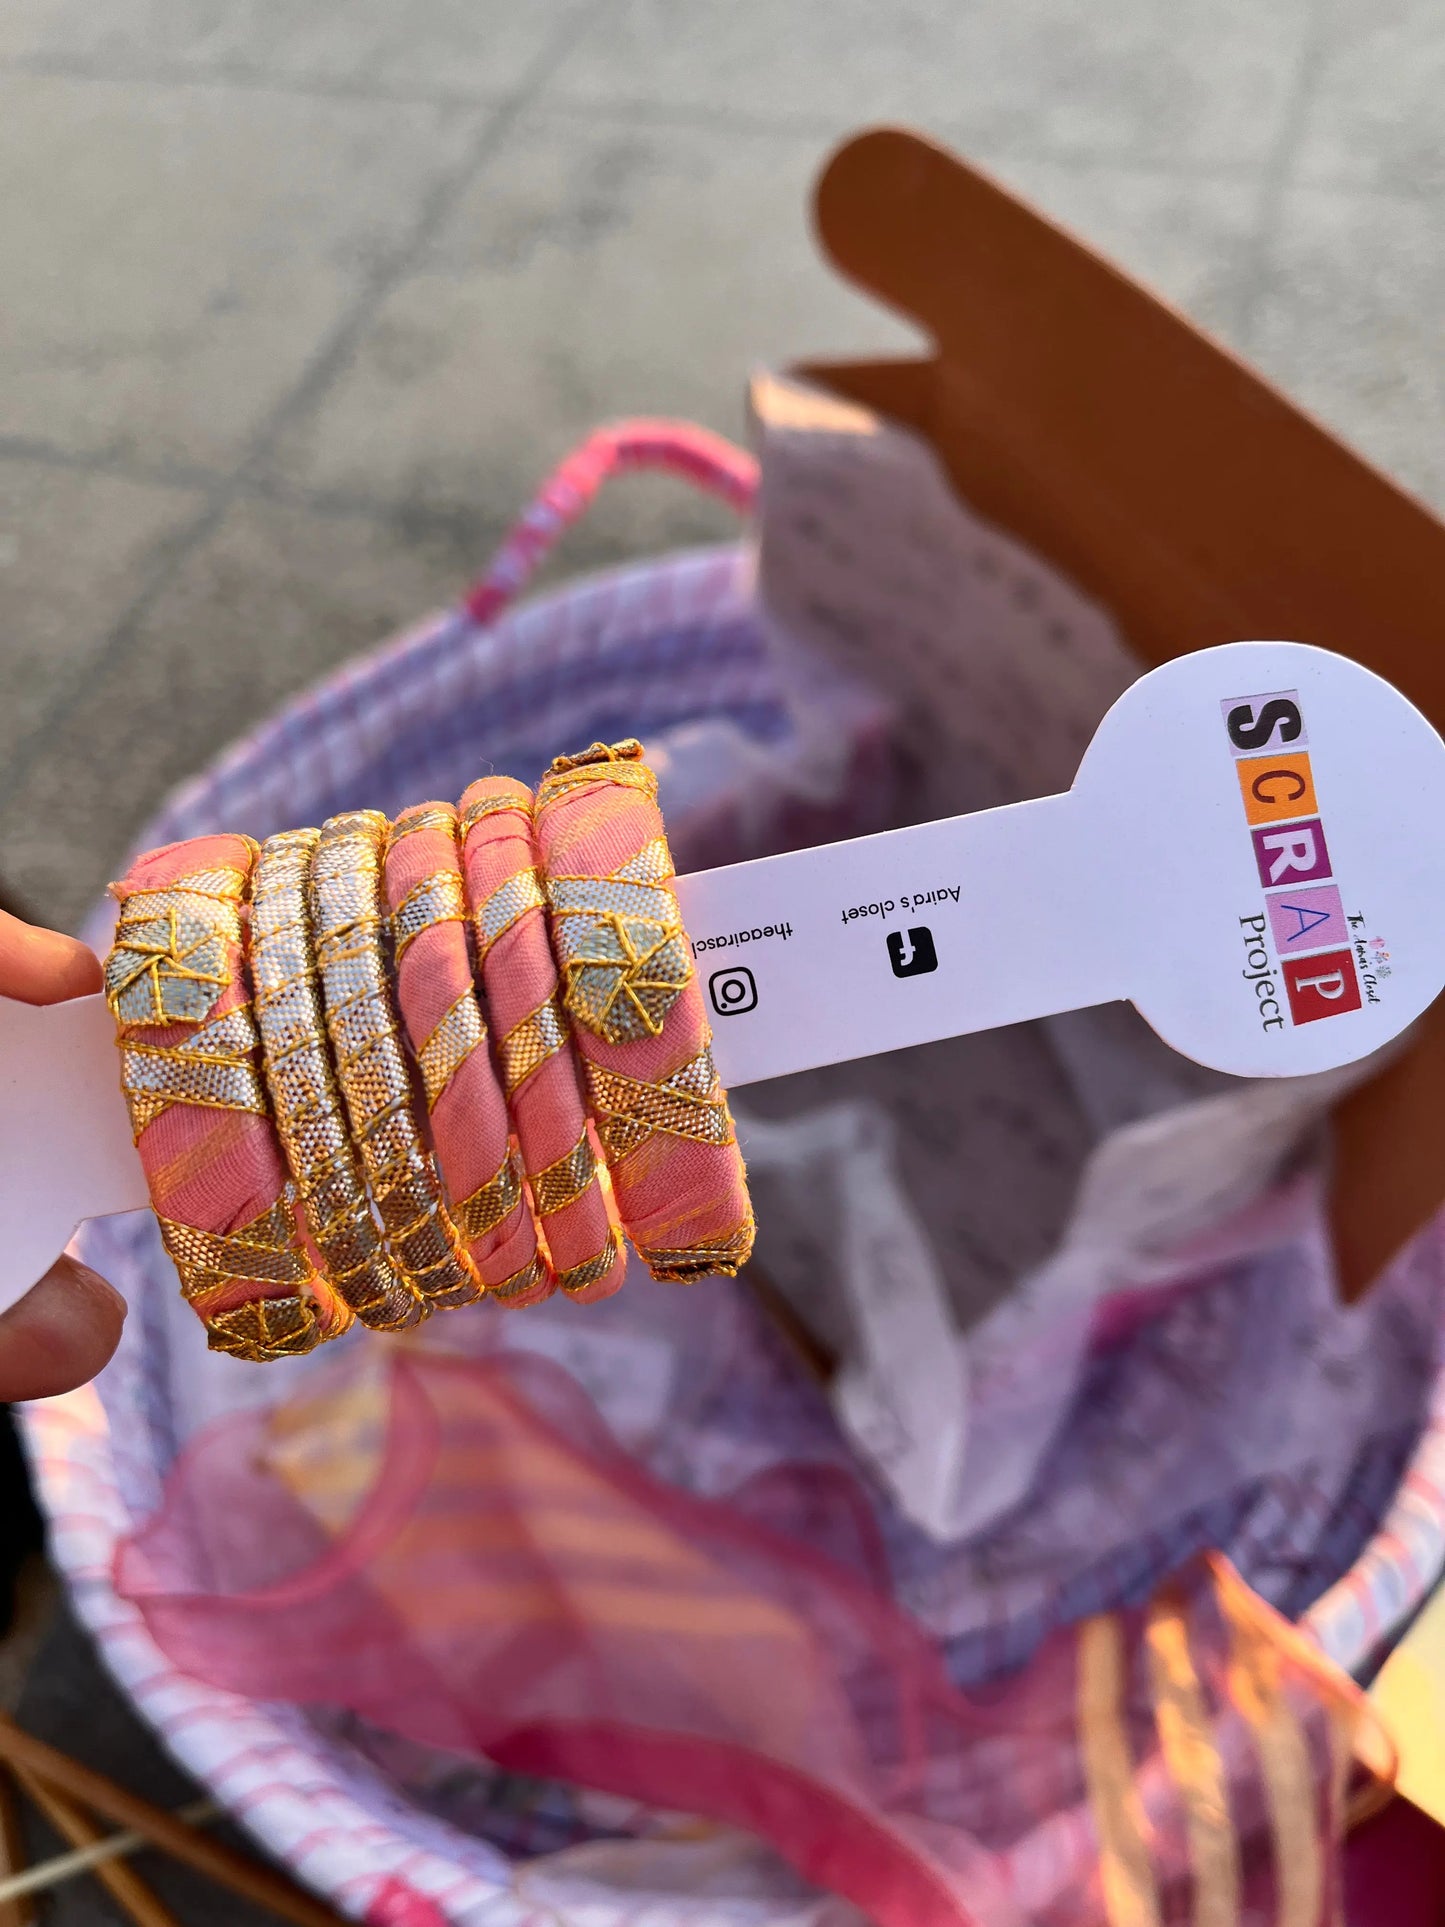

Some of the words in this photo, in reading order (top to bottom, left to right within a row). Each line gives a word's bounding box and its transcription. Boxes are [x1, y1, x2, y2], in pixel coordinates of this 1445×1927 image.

[1227, 699, 1344, 1000] SCRAP
[842, 900, 895, 924] closet
[900, 886, 961, 913] Aaira's
[1238, 911, 1284, 1033] Project
[1346, 910, 1366, 930] The
[1362, 973, 1381, 1004] Closet
